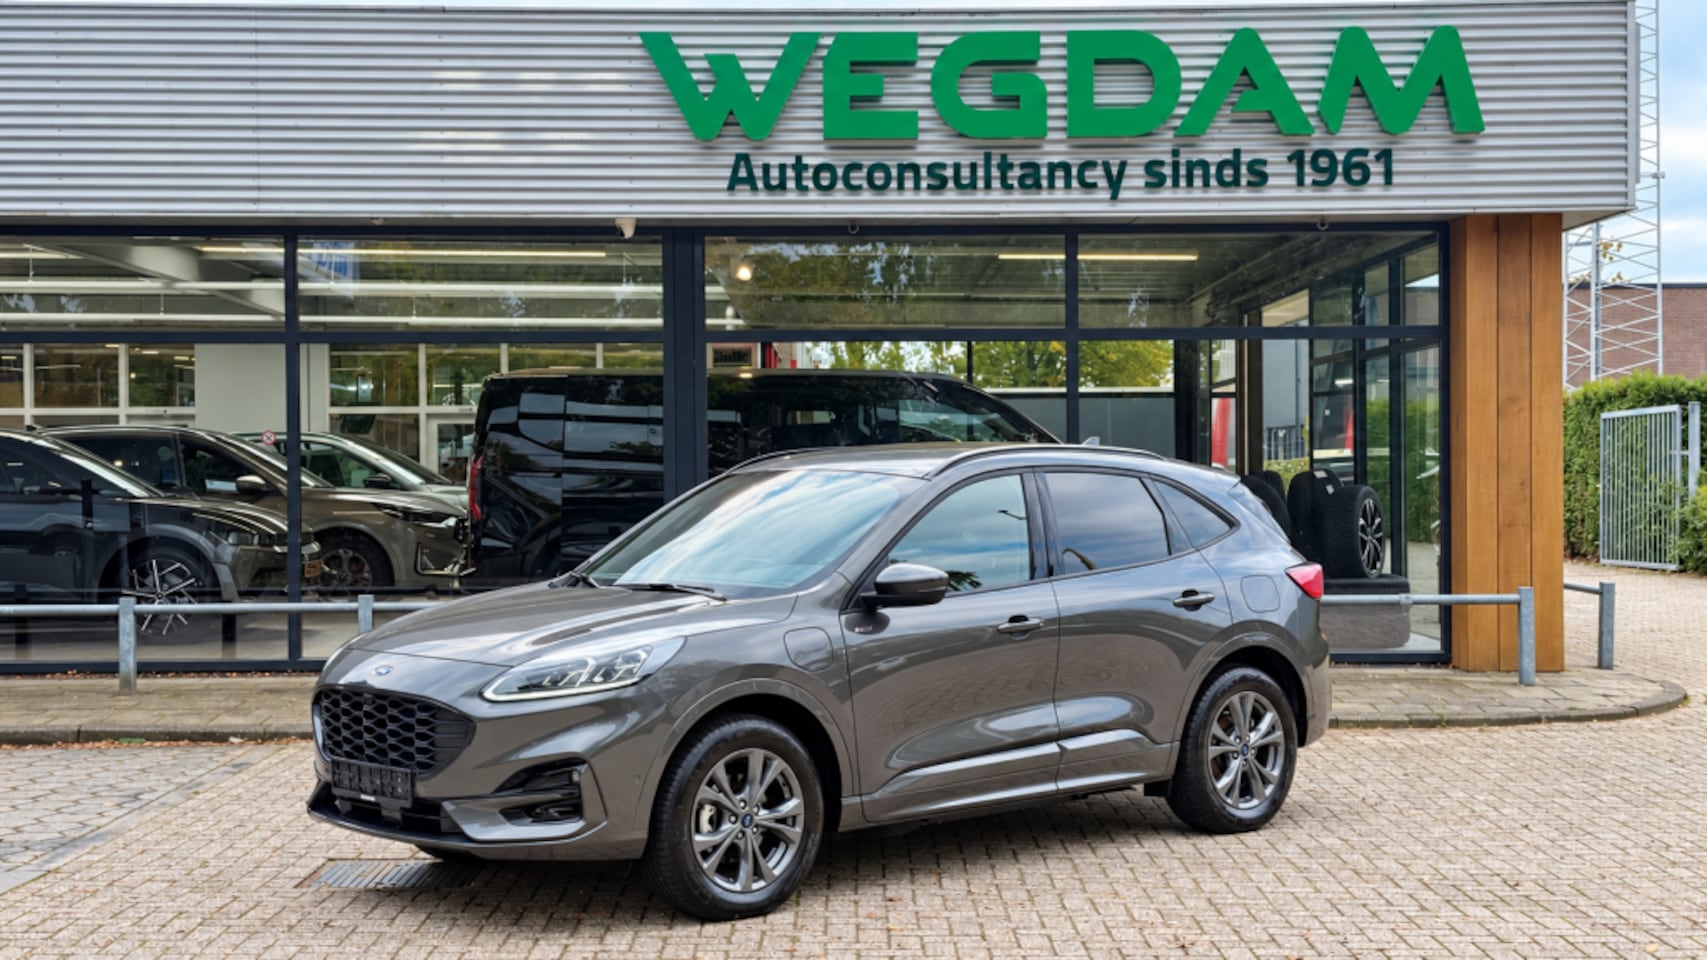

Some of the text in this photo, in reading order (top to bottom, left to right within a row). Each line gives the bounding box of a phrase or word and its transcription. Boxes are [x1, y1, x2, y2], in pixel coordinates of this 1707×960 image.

[639, 25, 1486, 141] WEGDAM
[727, 147, 1395, 201] Autoconsultancy sinds 1961
